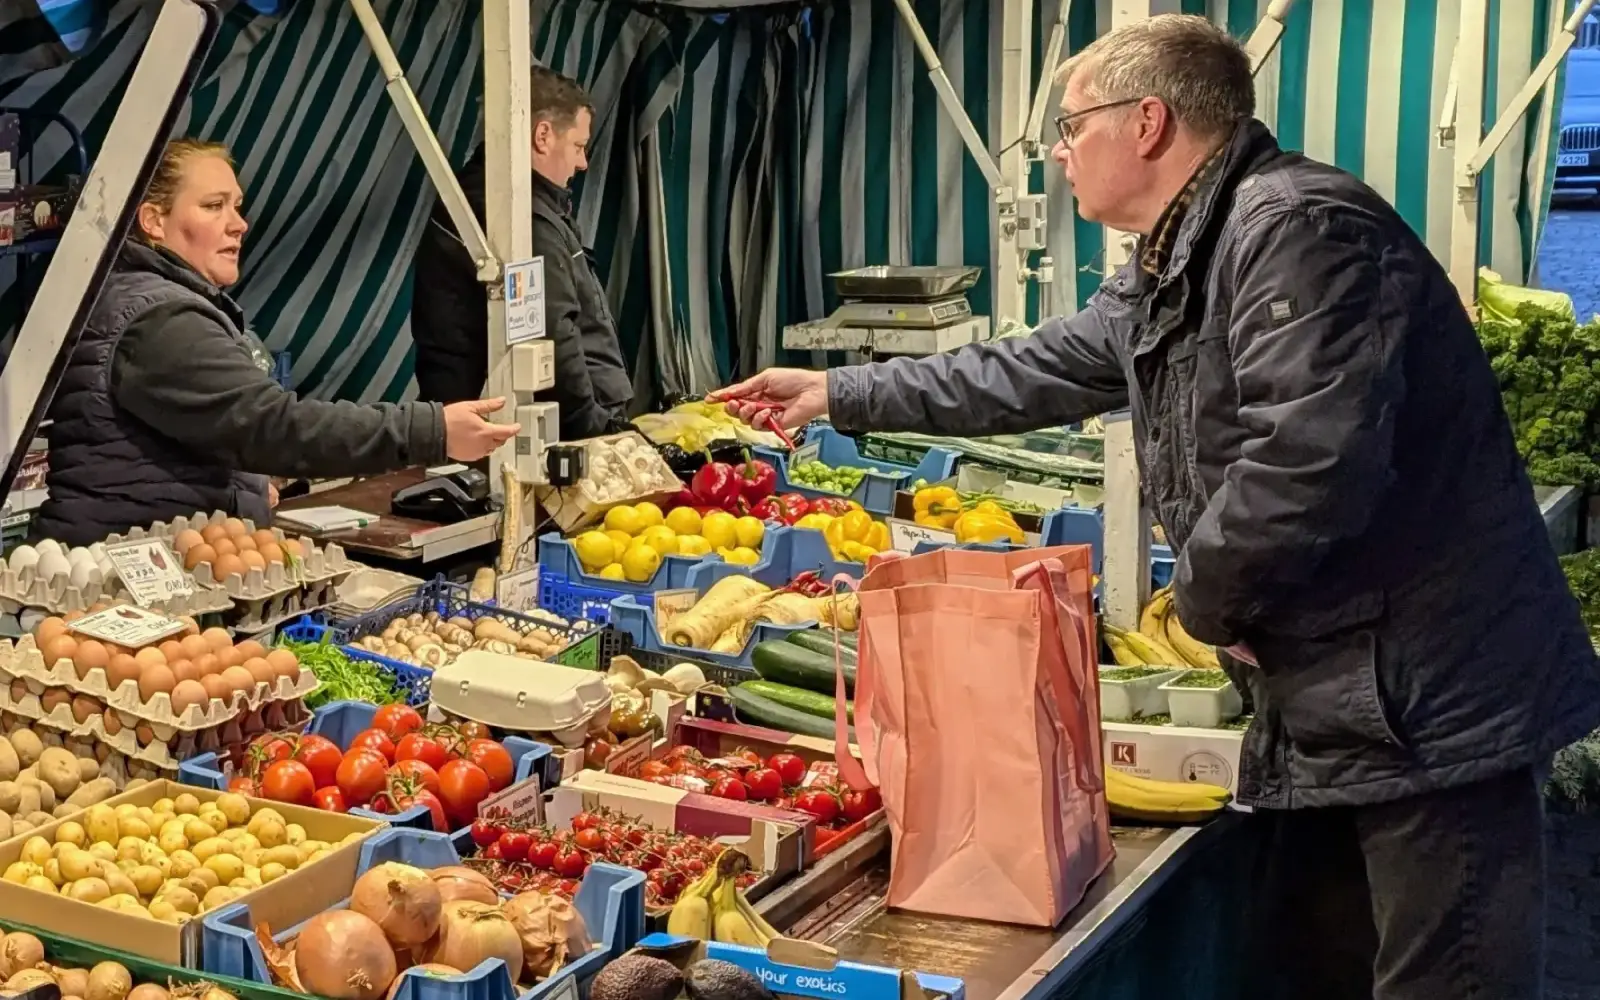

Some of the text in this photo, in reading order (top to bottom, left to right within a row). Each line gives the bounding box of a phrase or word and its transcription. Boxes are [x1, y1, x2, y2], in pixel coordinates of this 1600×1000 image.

[1118, 745, 1131, 763] K
[755, 966, 847, 994] your exotics
